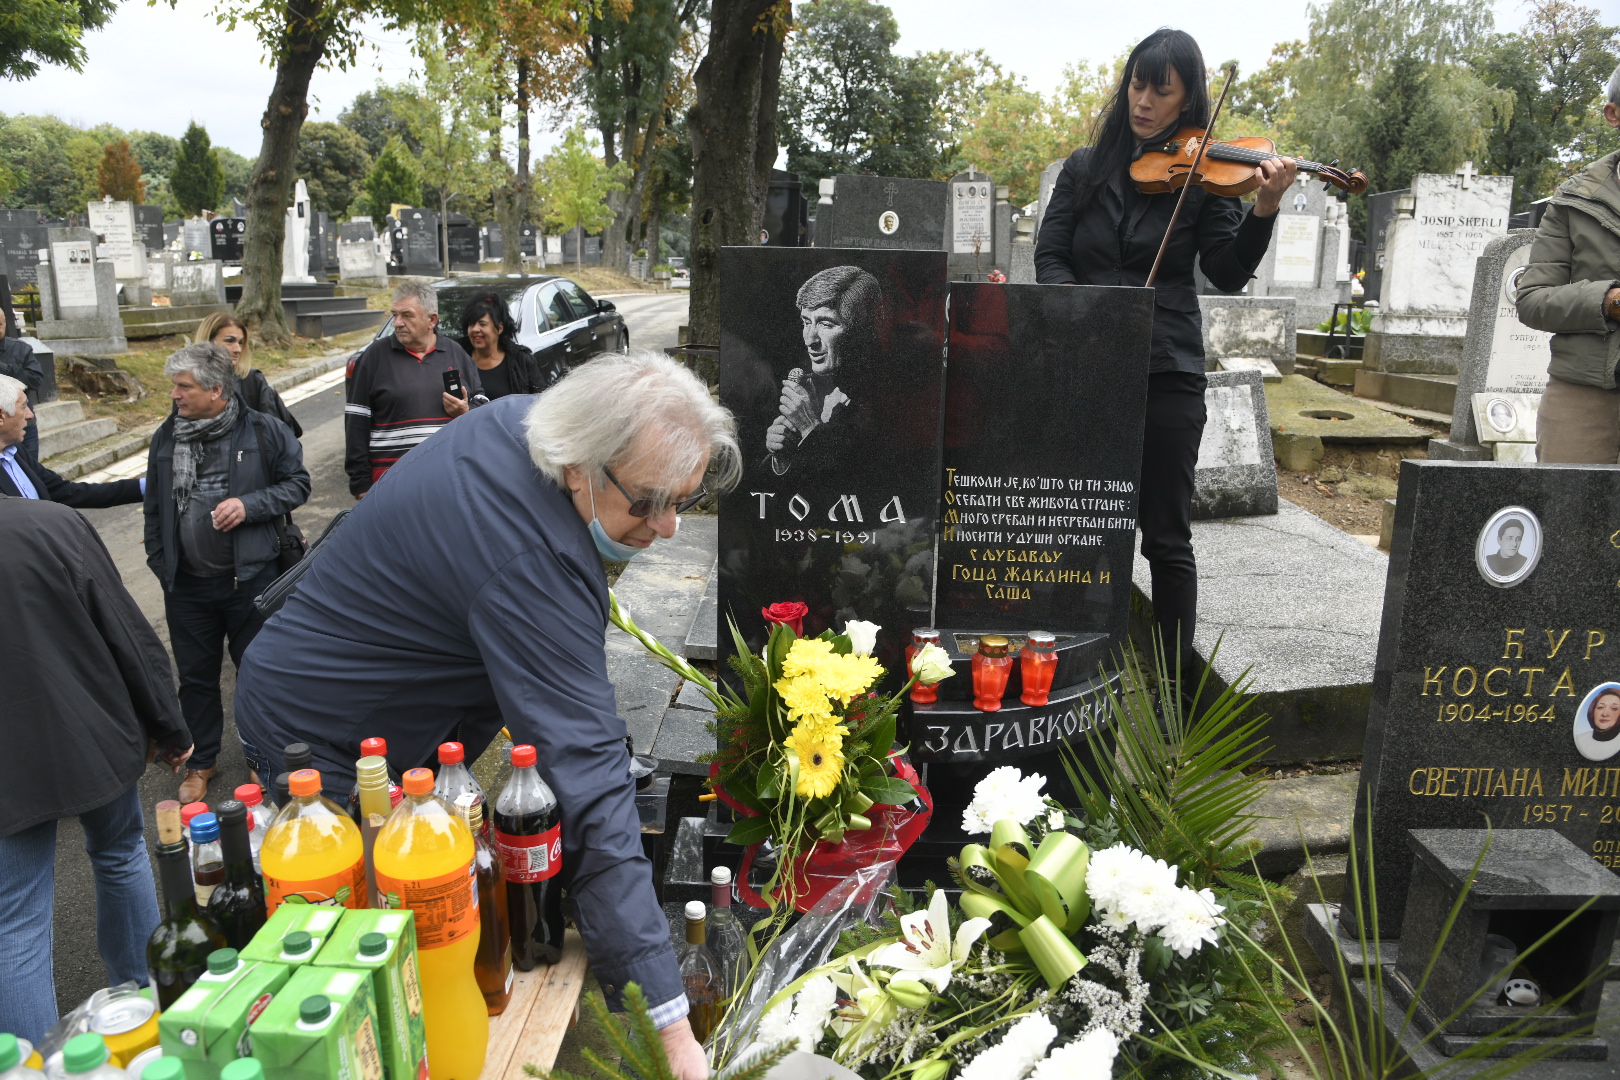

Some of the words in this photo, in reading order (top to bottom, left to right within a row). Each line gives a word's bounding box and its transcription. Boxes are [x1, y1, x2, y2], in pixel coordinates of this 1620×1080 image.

[1420, 215, 1455, 226] JOSIP
[1086, 480, 1101, 492] ТИ
[750, 491, 906, 524] ТОМА
[1005, 494, 1026, 508] СВЕ
[1028, 496, 1078, 510] ЖИВОТА
[944, 508, 990, 525] МНОГО
[970, 548, 978, 561] С
[952, 564, 997, 580] ГОЦА
[1004, 566, 1092, 584] ЖАКЛИНА
[1099, 571, 1111, 584] И
[985, 584, 1031, 600] САША
[1420, 665, 1576, 698] КОСТА
[1436, 703, 1556, 723] 1904-1964
[1408, 766, 1544, 798] СВЕТЛАНА
[1522, 804, 1573, 822] 1957
